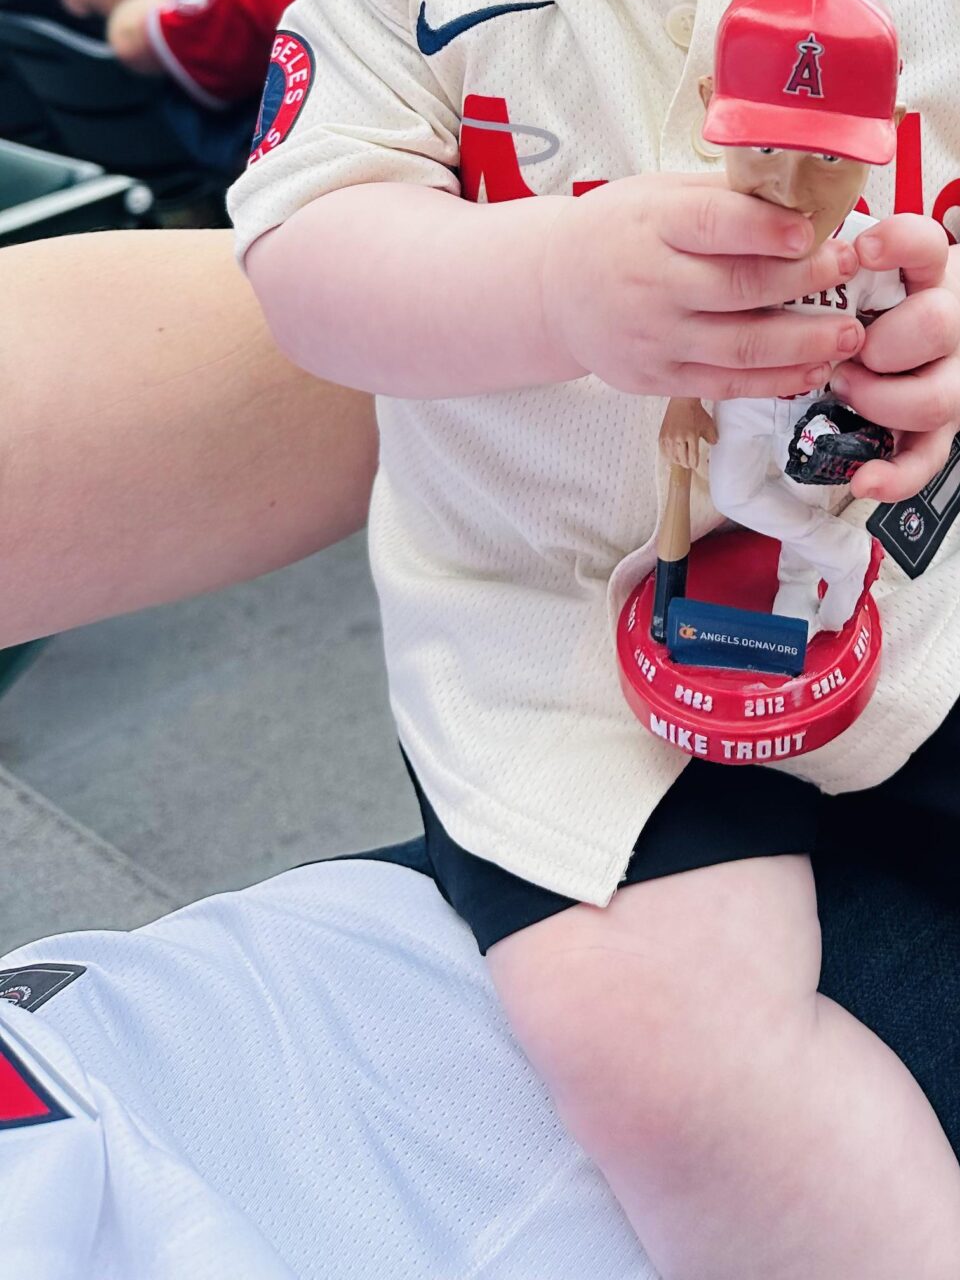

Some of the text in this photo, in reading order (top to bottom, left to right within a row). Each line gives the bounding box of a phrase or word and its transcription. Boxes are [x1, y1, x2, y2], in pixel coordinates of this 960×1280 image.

[783, 32, 824, 98] A
[699, 631, 798, 656] ANGELS.OCNAV.ORG
[744, 696, 785, 717] 2012
[650, 712, 807, 760] MIKE TROUT
